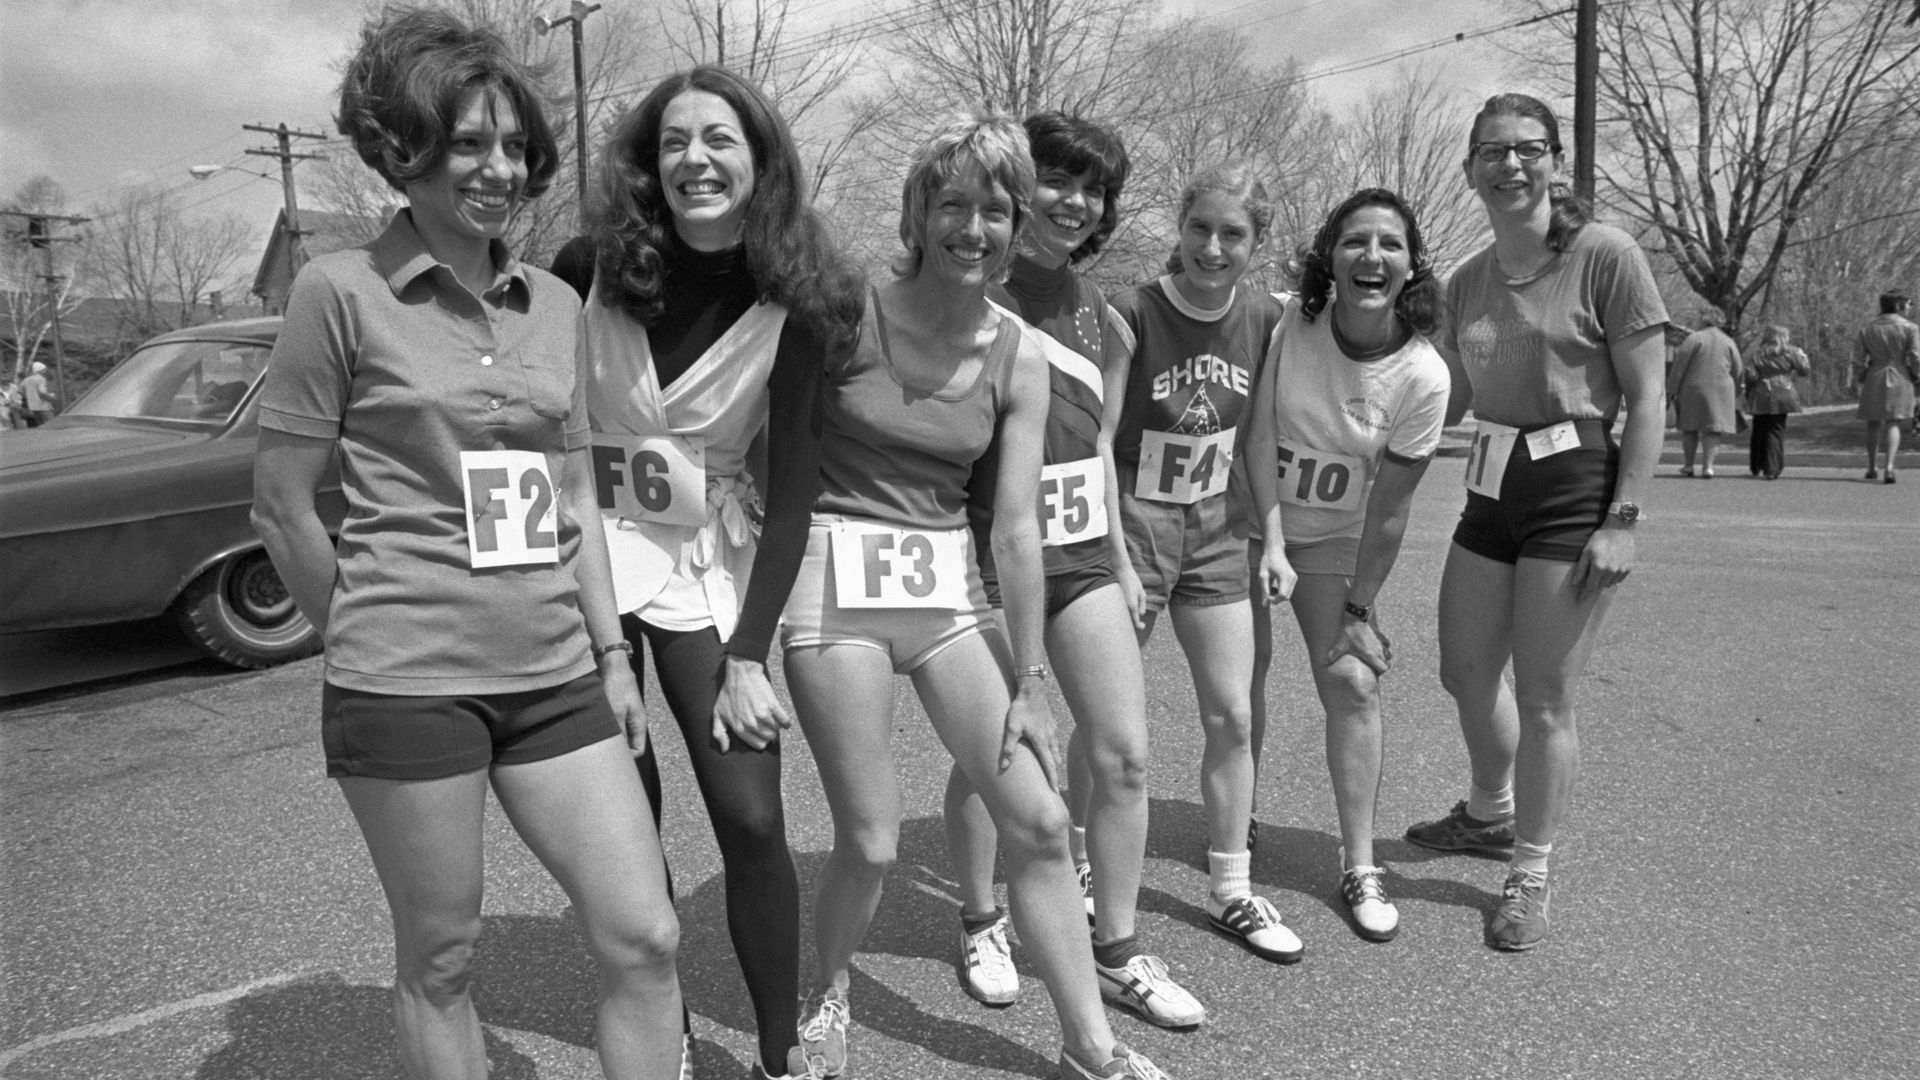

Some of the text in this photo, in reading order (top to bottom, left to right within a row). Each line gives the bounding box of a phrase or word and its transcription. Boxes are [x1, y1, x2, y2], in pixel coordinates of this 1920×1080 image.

[1152, 354, 1248, 400] SHORE
[592, 445, 672, 512] F6
[1158, 443, 1218, 494] F4
[468, 467, 556, 552] F2
[1036, 474, 1089, 539] F5
[861, 533, 937, 598] F3
